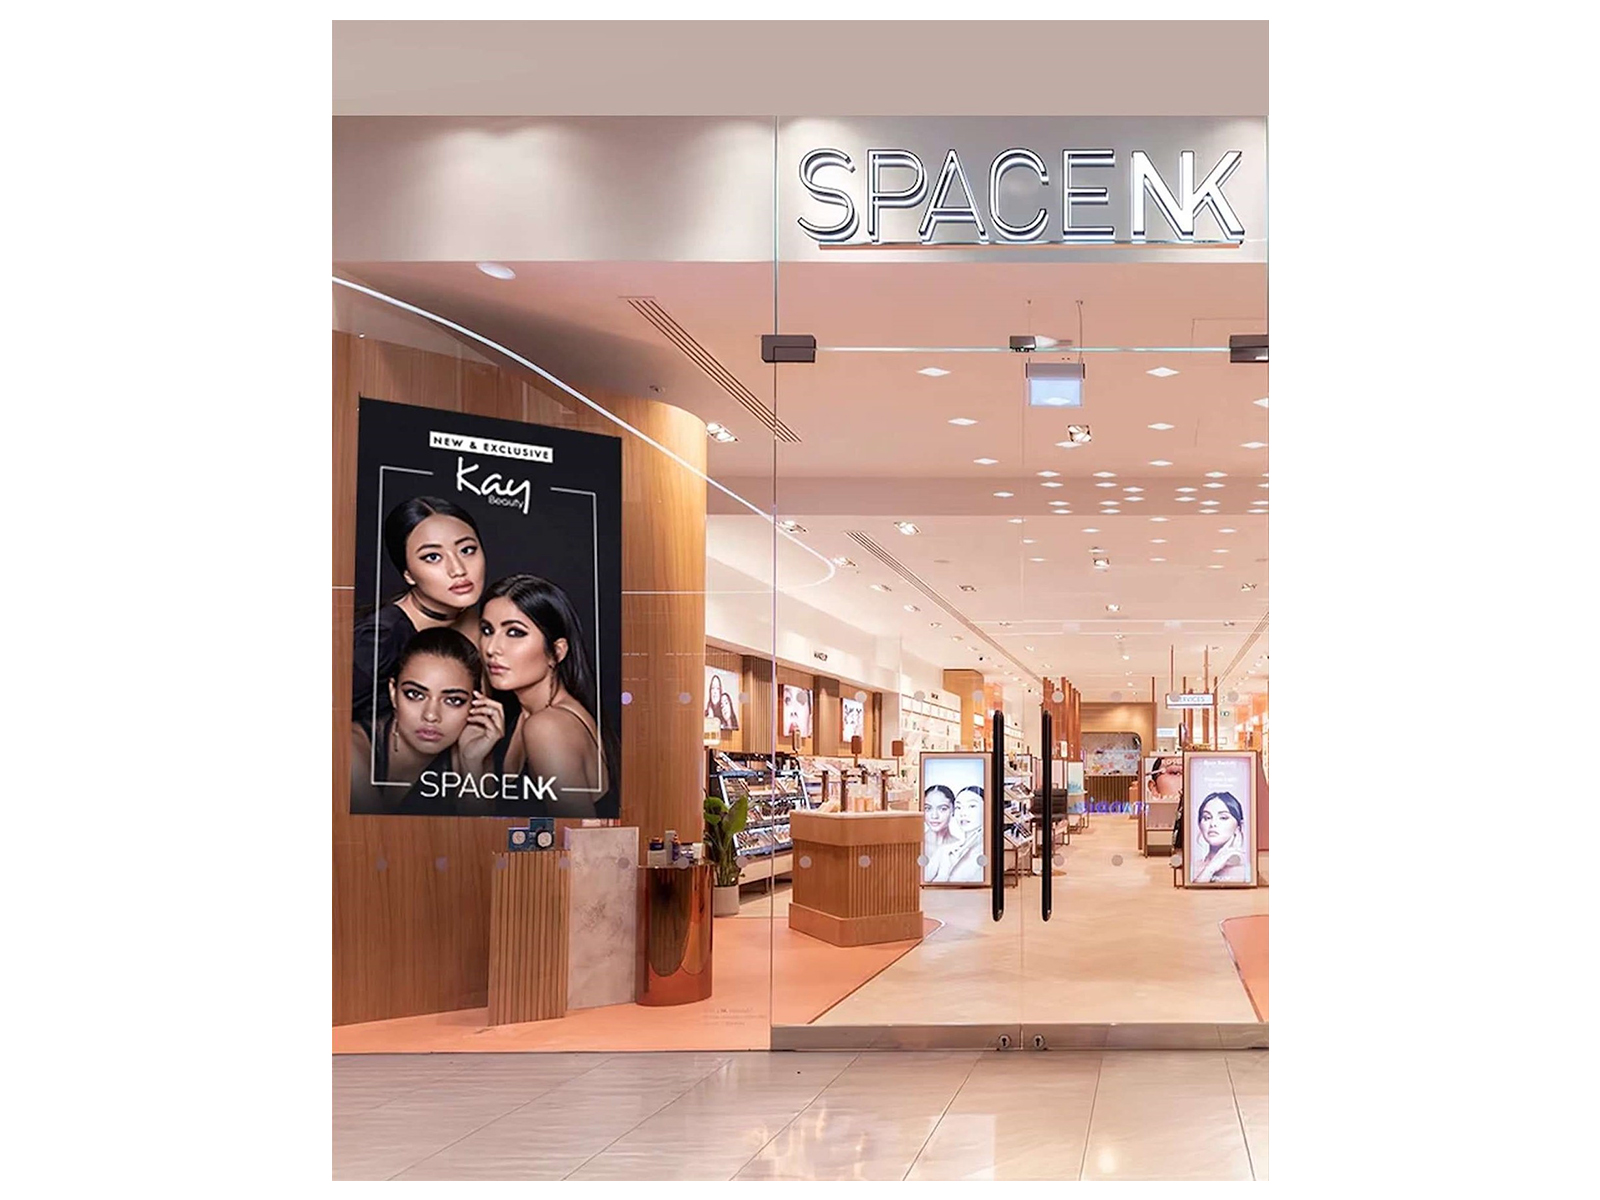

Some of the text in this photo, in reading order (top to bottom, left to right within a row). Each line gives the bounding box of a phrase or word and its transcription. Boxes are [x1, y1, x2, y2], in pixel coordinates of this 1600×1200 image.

[433, 436, 549, 460] NEW & EXCLUSIVE
[456, 456, 531, 515] Kay
[488, 494, 525, 510] Beauty
